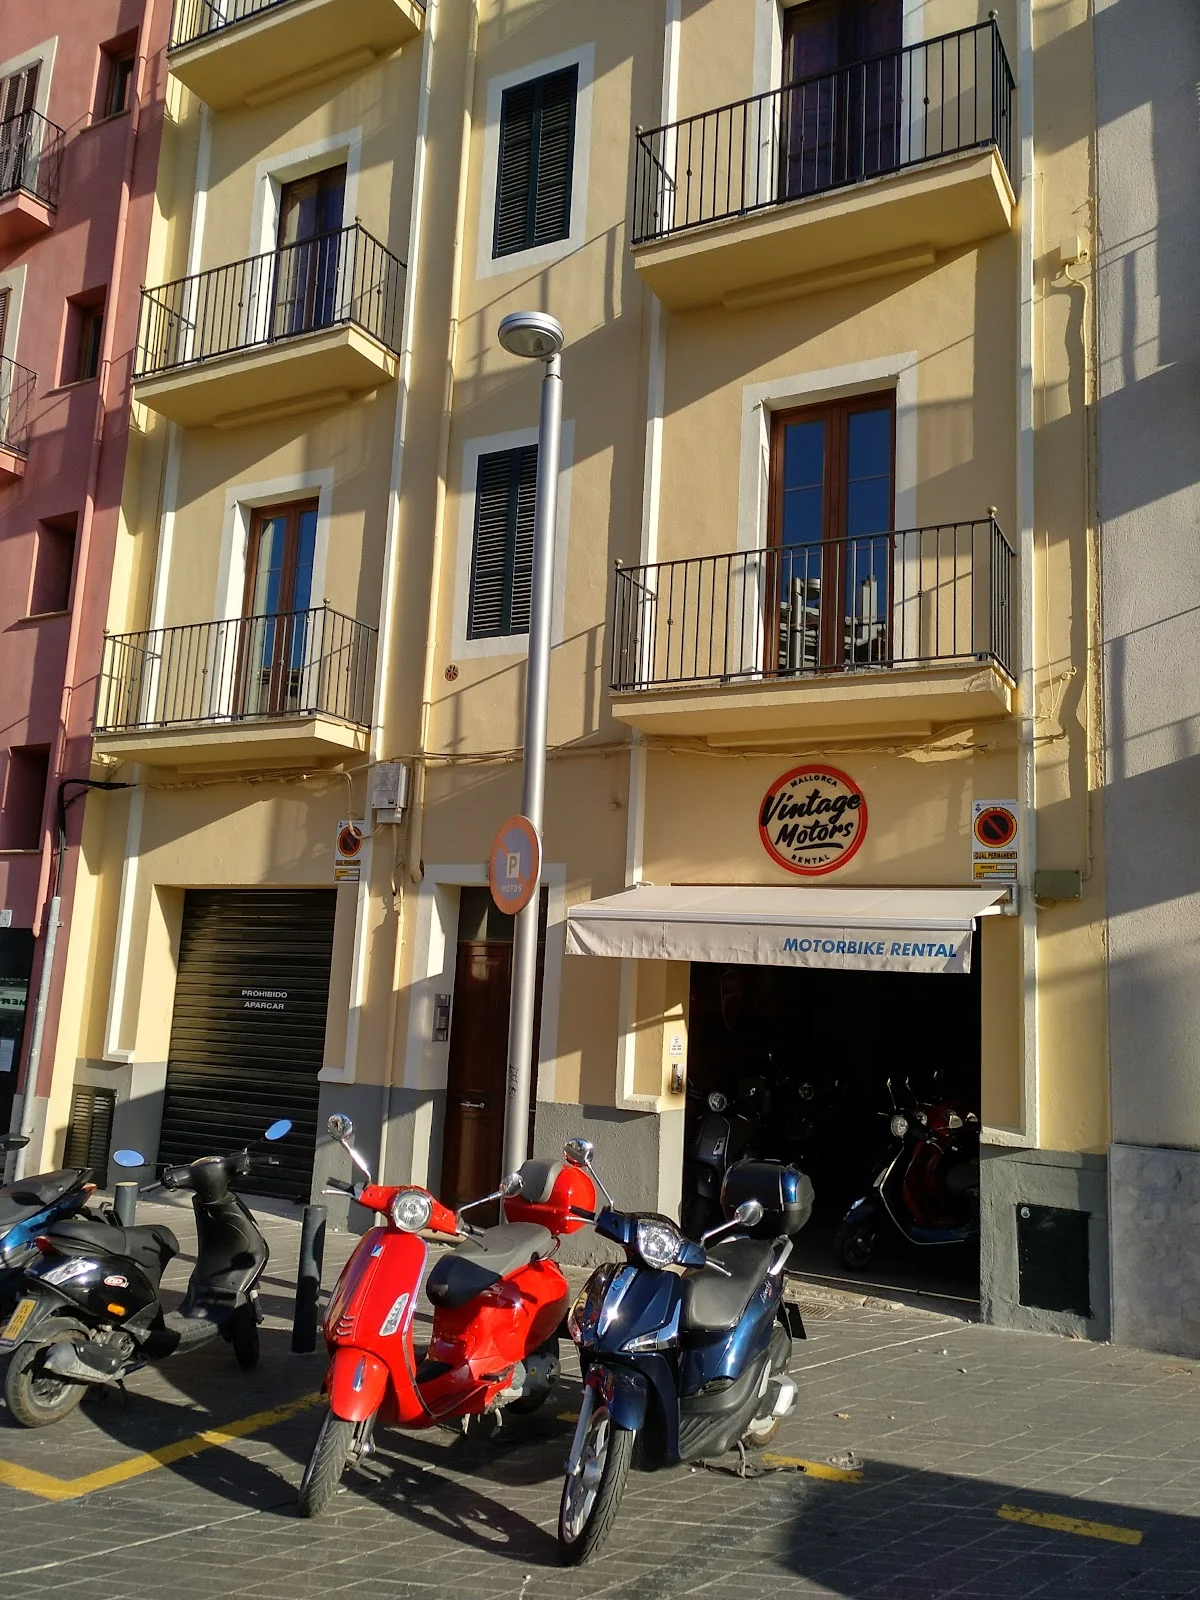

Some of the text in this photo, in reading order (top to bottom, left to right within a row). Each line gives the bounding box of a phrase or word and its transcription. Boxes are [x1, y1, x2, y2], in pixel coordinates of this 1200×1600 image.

[790, 774, 838, 788] MALLORCA
[760, 788, 861, 827] Vintage
[774, 819, 854, 848] Motors
[509, 856, 518, 875] P
[791, 854, 830, 865] RENTAL
[501, 884, 522, 893] MOTOS
[783, 938, 957, 958] MOTORBIKE RENTAL
[242, 990, 288, 998] PROHIBIDO
[244, 1002, 284, 1010] APARCAR
